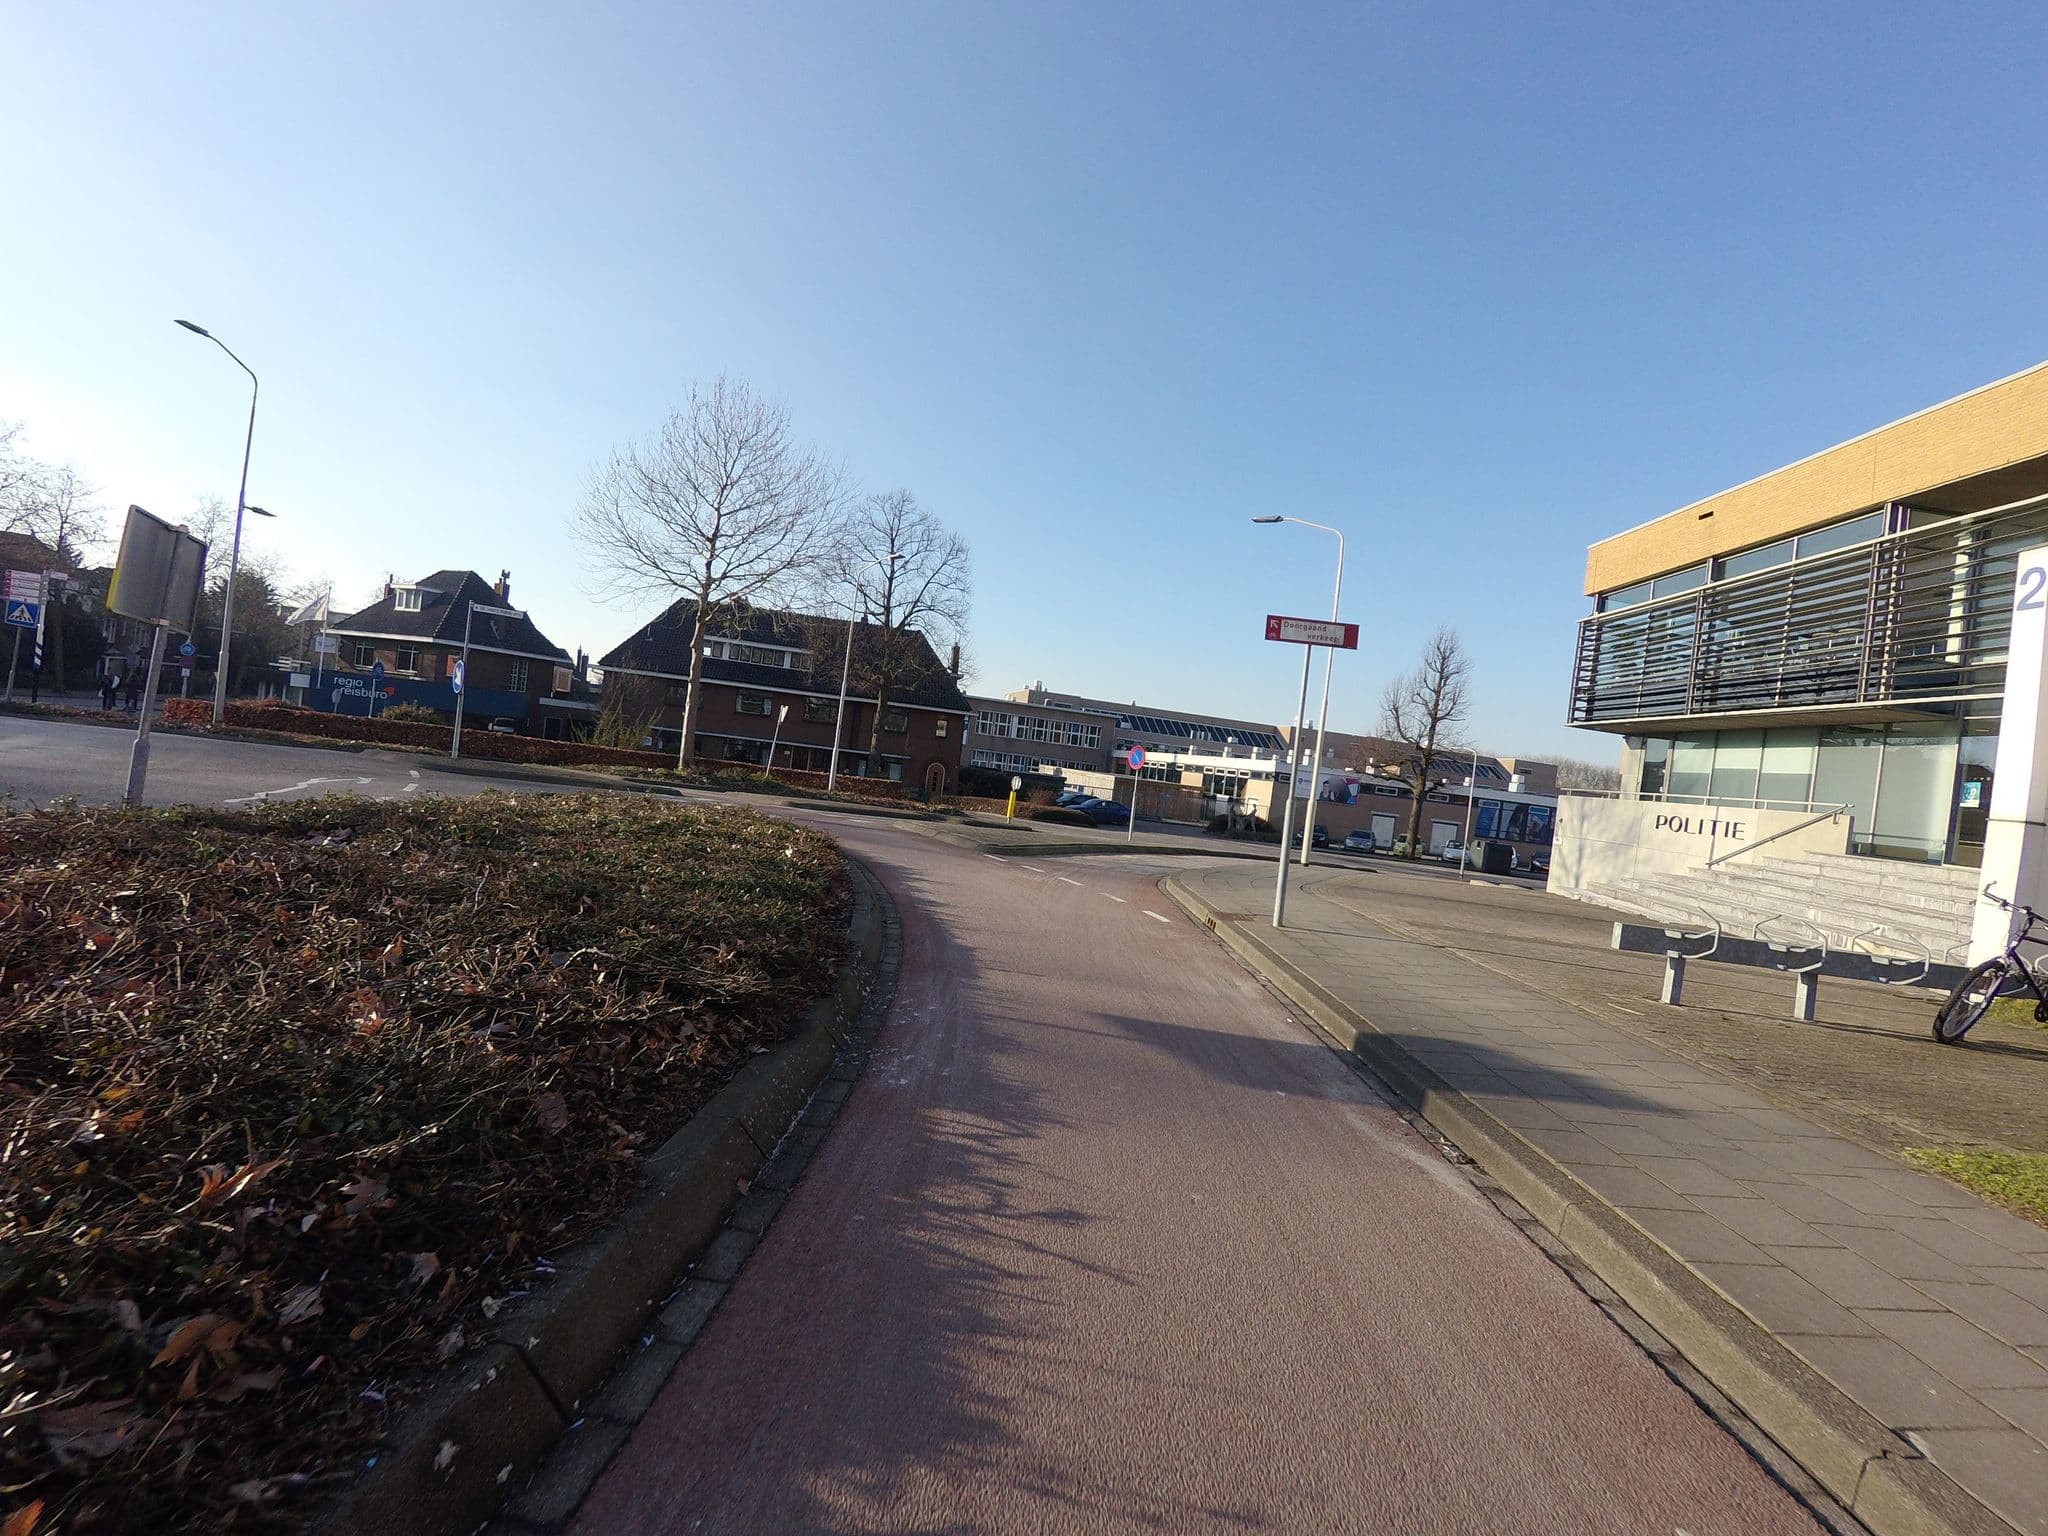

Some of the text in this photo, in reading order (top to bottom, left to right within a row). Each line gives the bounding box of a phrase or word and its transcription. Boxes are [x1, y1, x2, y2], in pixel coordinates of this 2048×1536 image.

[2016, 566, 2047, 612] 2
[1283, 621, 1327, 632] Doorgaand
[333, 677, 363, 688] regio
[340, 687, 388, 699] reisburo
[1655, 814, 1746, 841] POLITIE
